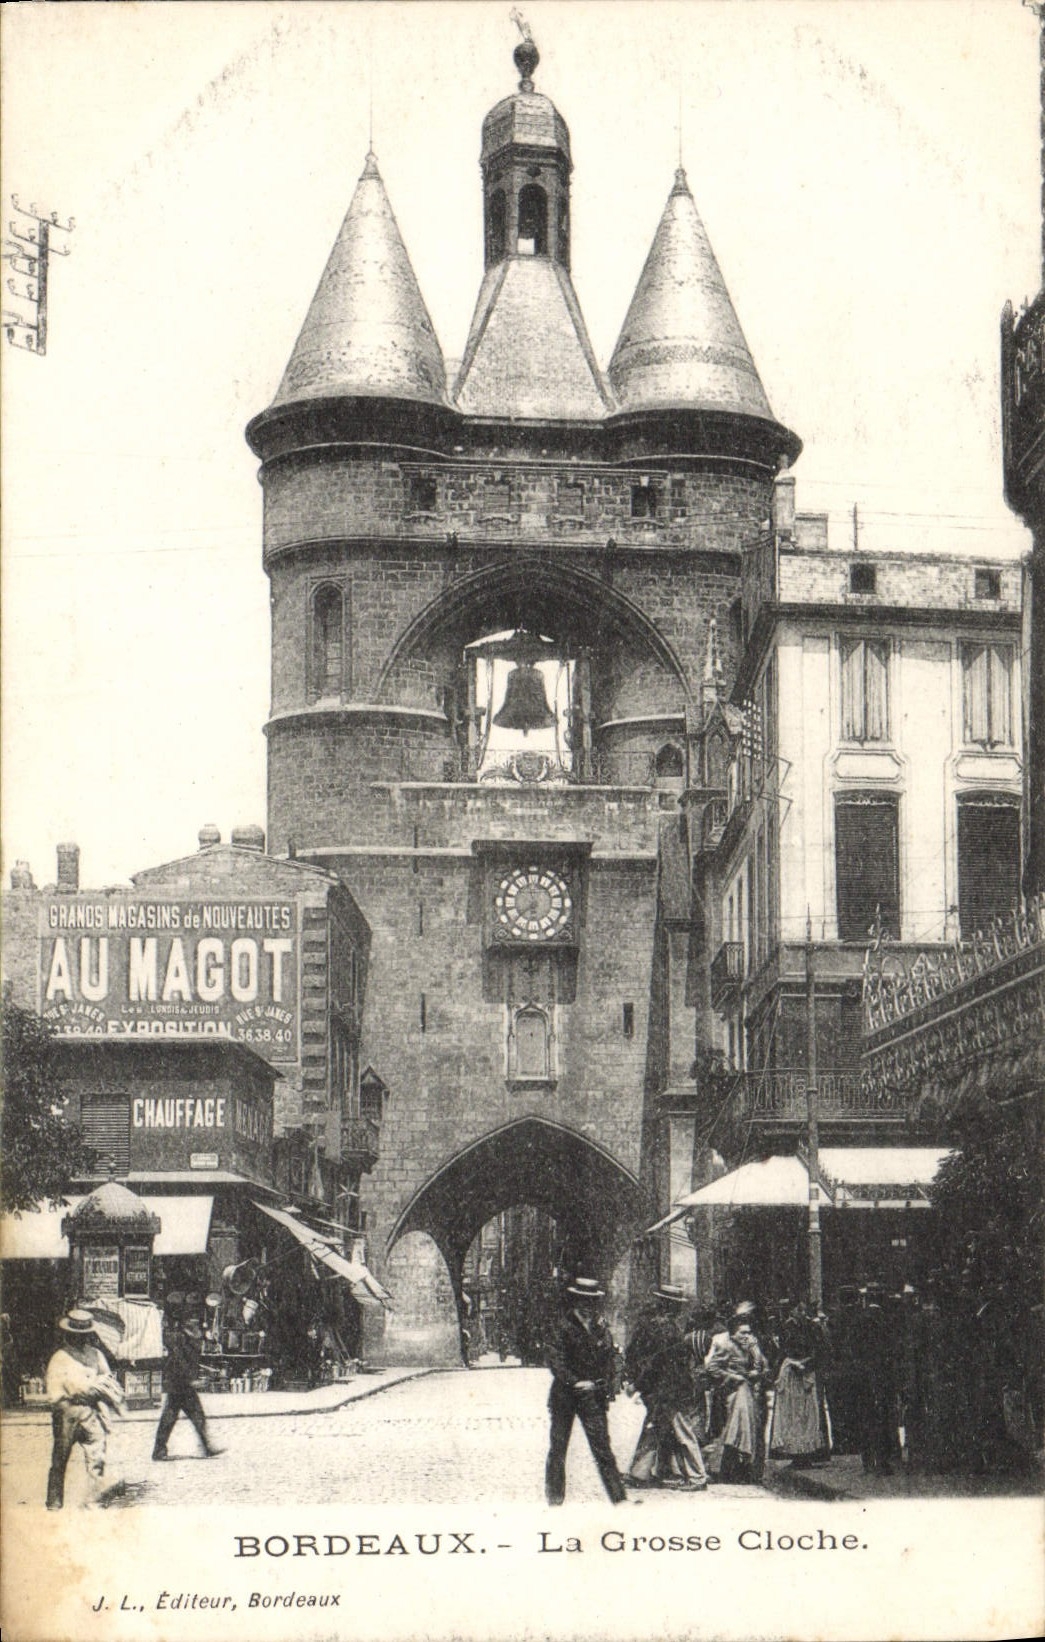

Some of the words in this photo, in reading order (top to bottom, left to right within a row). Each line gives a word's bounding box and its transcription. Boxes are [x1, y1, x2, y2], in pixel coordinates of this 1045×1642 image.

[50, 904, 103, 929] GRANDS
[108, 905, 181, 929] MAGASINS
[184, 909, 201, 929] de
[46, 937, 109, 1001] AU
[129, 937, 293, 1002] MAGOT
[71, 1003, 105, 1022] JAMES
[235, 1007, 254, 1025] RUE
[264, 1005, 293, 1025] JAMES
[107, 1020, 232, 1036] EXPOSITION
[133, 1098, 226, 1128] CHAUFFAGE
